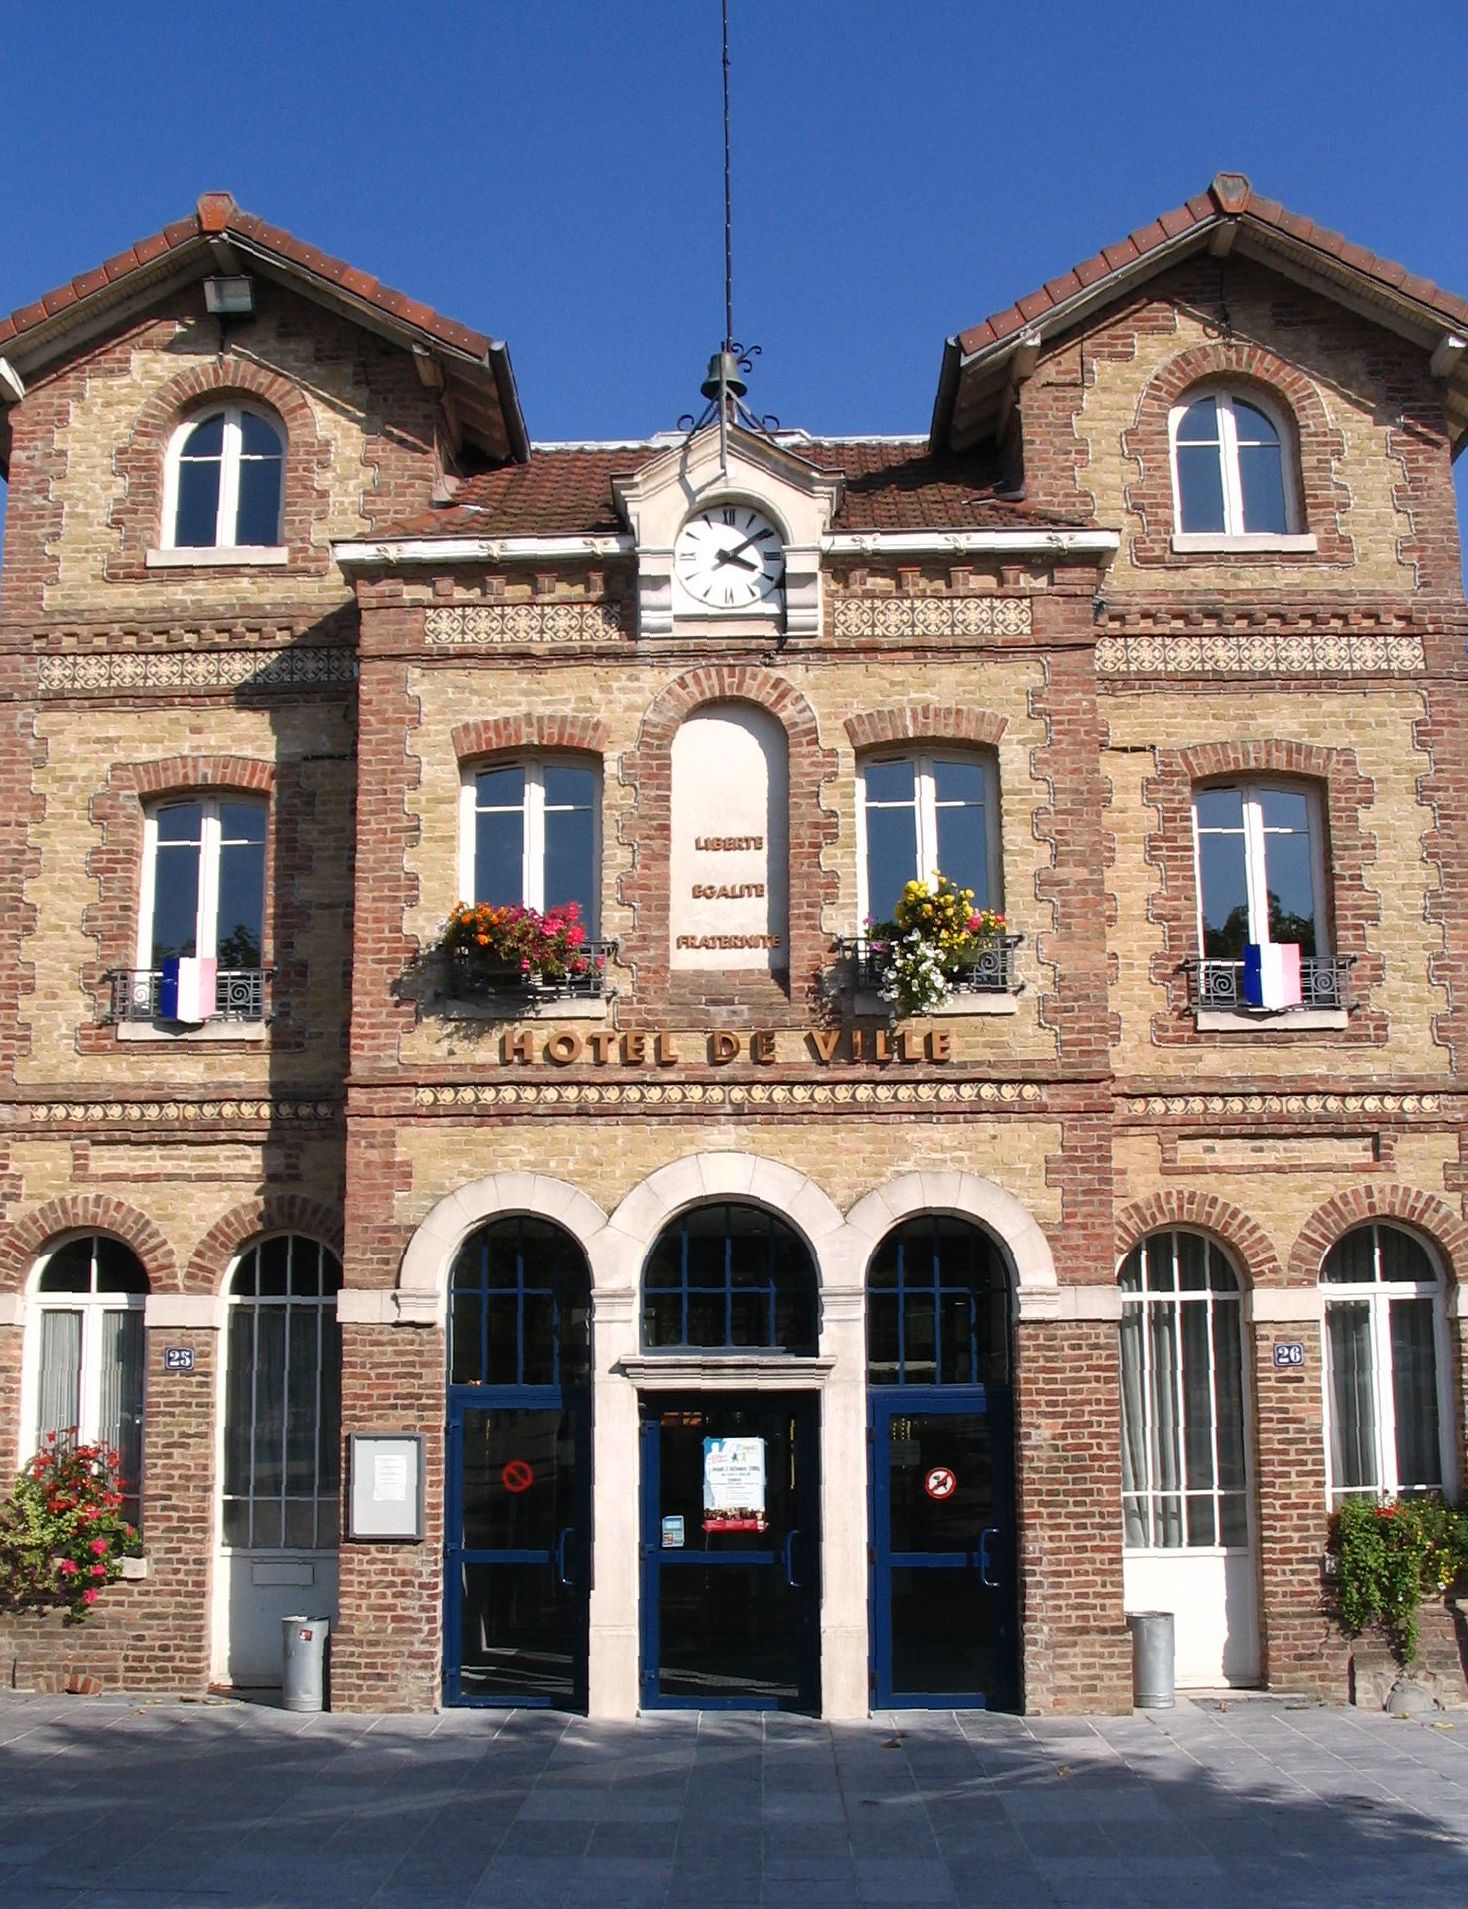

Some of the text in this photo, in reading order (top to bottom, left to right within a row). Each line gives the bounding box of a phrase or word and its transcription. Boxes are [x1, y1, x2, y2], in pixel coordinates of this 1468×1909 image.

[694, 836, 764, 851] LIBERTE
[692, 883, 765, 899] EGALITE
[676, 934, 781, 949] FRATERNITE
[503, 1029, 951, 1064] HOTEL DE VILLE
[169, 1350, 191, 1366] 25
[1278, 1346, 1301, 1363] 26
